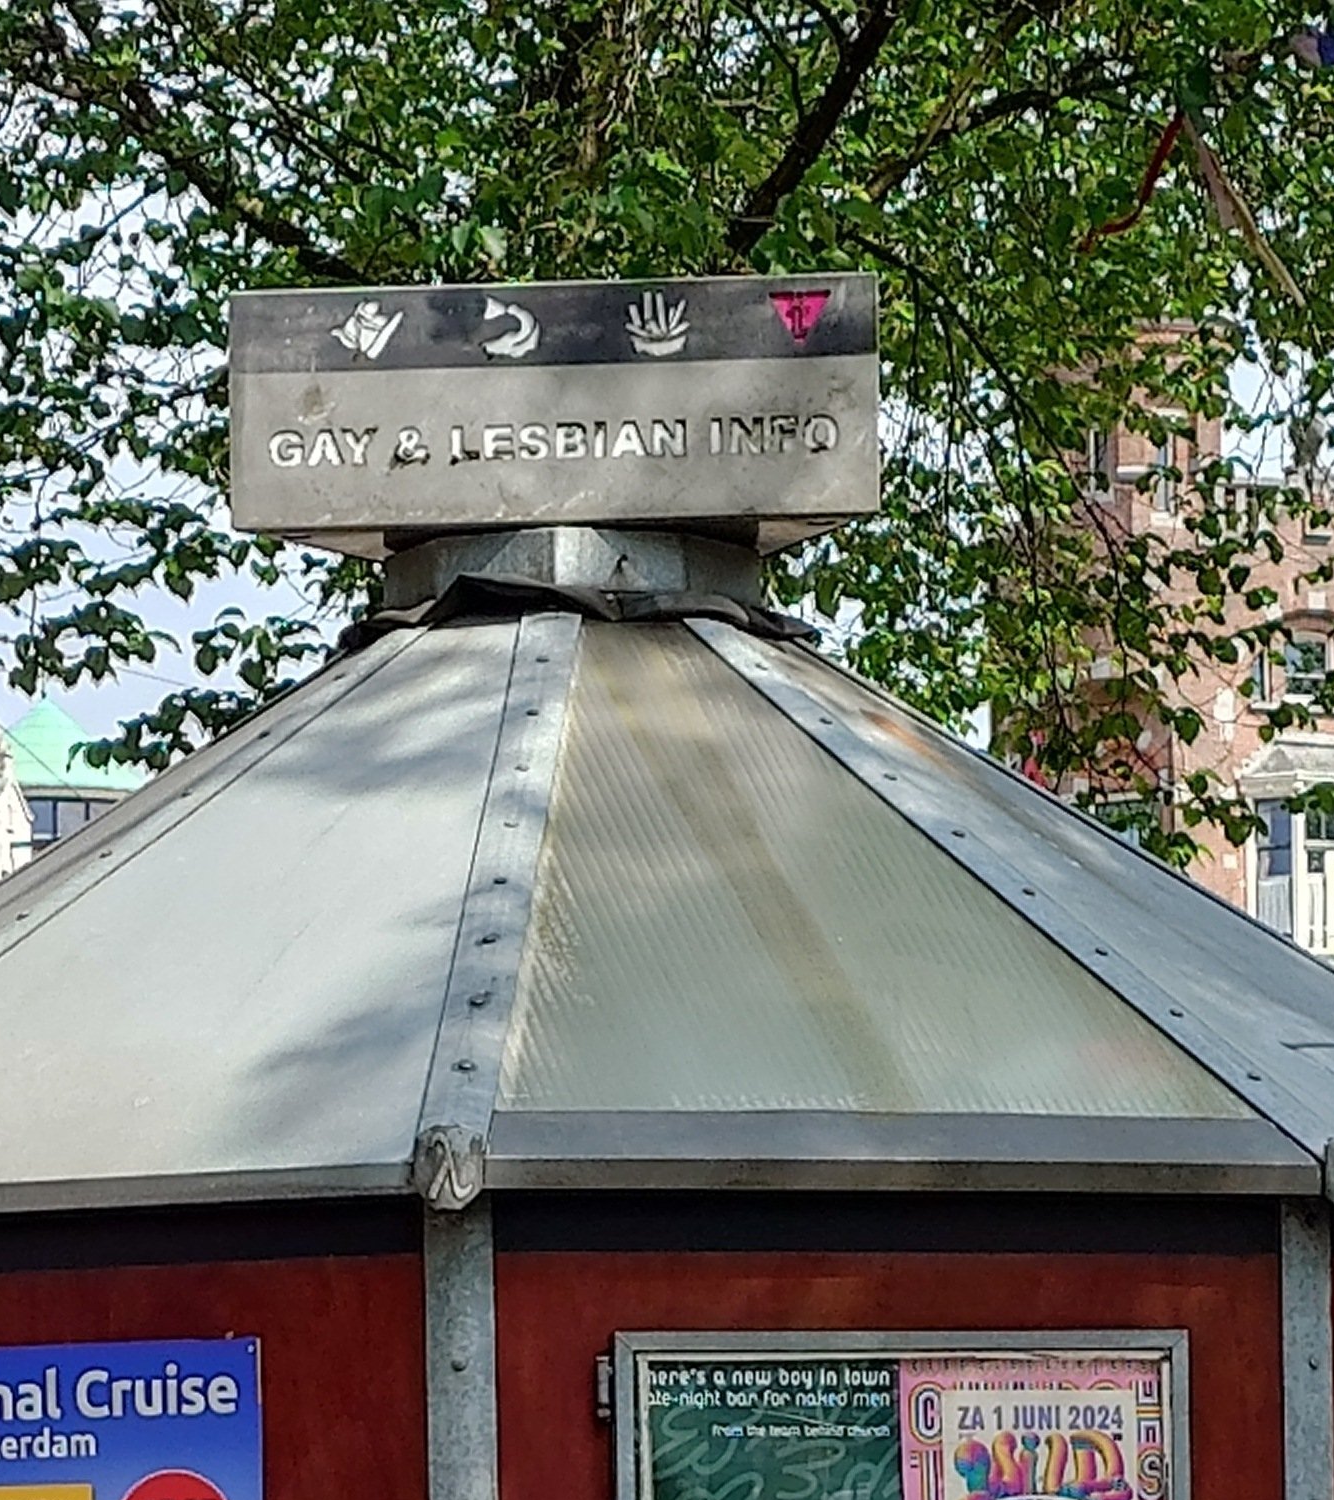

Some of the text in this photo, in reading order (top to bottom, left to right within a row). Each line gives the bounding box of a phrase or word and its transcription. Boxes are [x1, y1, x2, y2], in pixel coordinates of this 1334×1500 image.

[269, 413, 841, 469] GAY & LESBIAN INFO
[75, 1362, 239, 1418] Cruise
[648, 1368, 706, 1387] here's
[713, 1370, 727, 1386] a
[732, 1369, 771, 1387] new
[778, 1368, 814, 1391] boy
[844, 1367, 891, 1387] town
[648, 1389, 891, 1410] ate-night bar for naked men
[957, 1404, 1124, 1431] ZA 1 JUNI 2024
